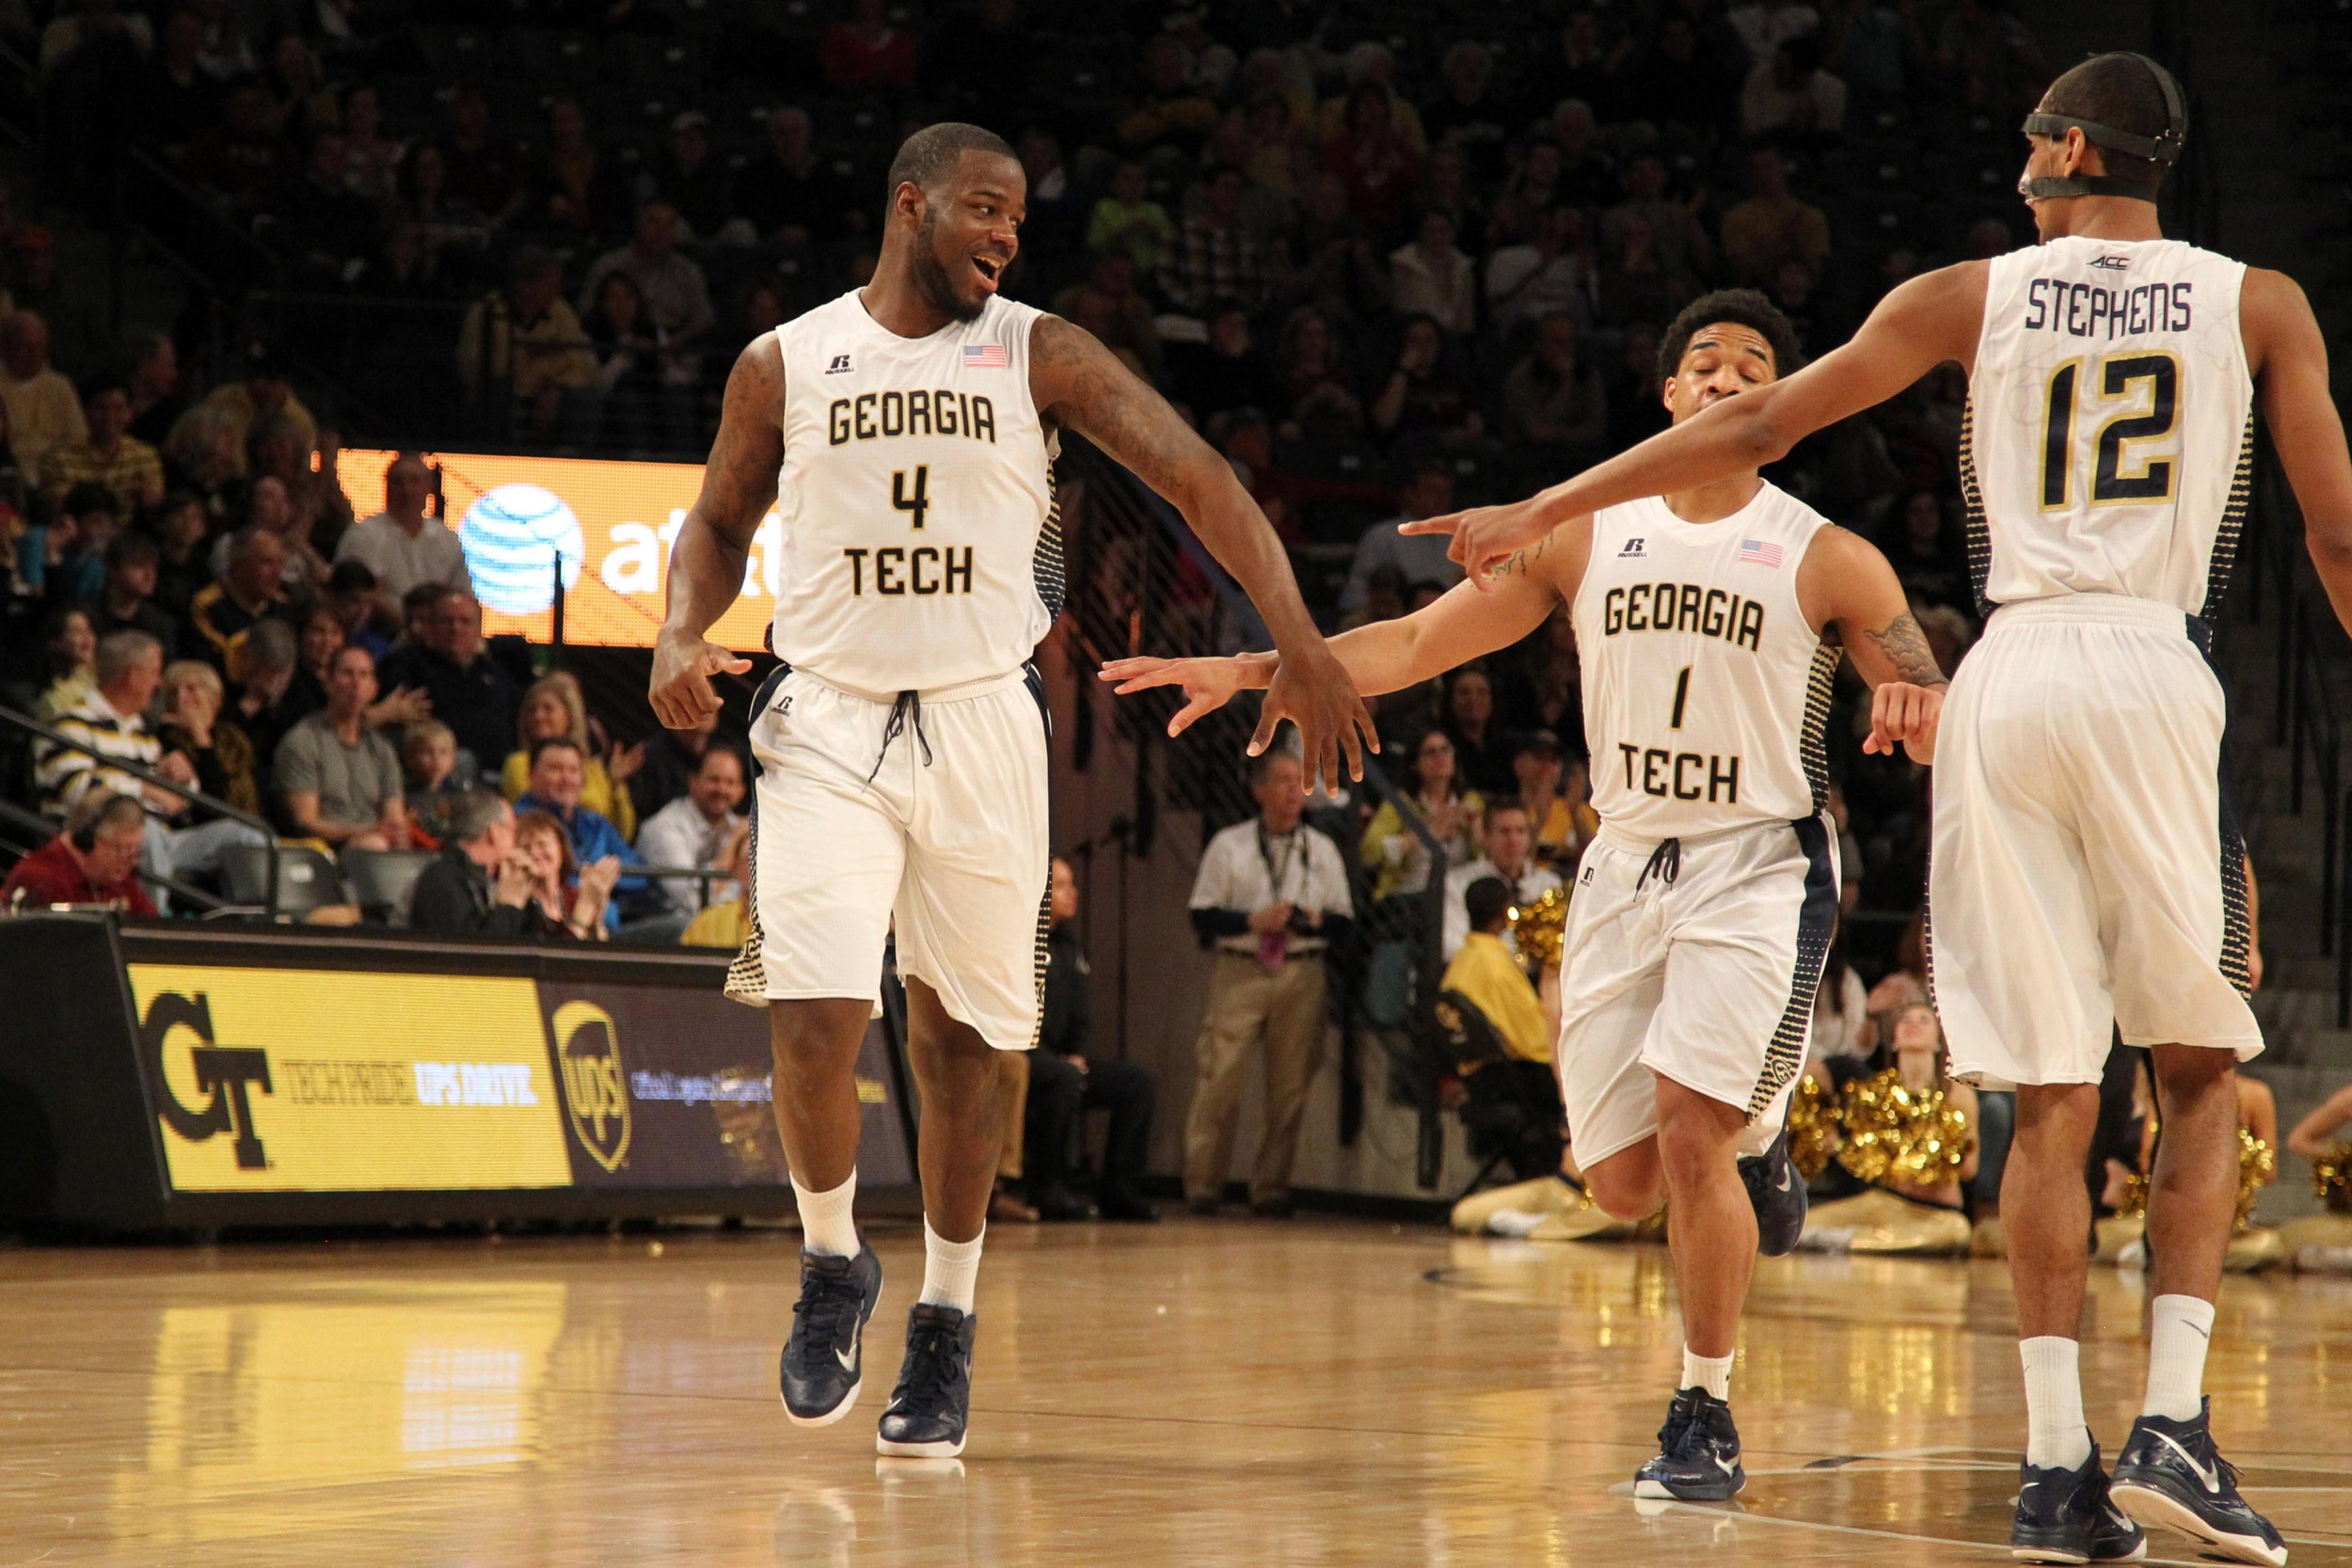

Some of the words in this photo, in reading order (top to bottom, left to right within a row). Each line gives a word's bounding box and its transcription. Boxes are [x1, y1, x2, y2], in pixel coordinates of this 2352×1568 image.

[2086, 256, 2130, 270] ACC
[2026, 278, 2192, 341] STEPHENS
[828, 388, 997, 447] GEORGIA
[2038, 349, 2184, 514] 12
[891, 464, 930, 531] 4
[843, 546, 974, 597] TECH
[1604, 582, 1766, 653] GEORGIA
[1669, 665, 1693, 732] 1
[1617, 741, 1740, 805] TECH
